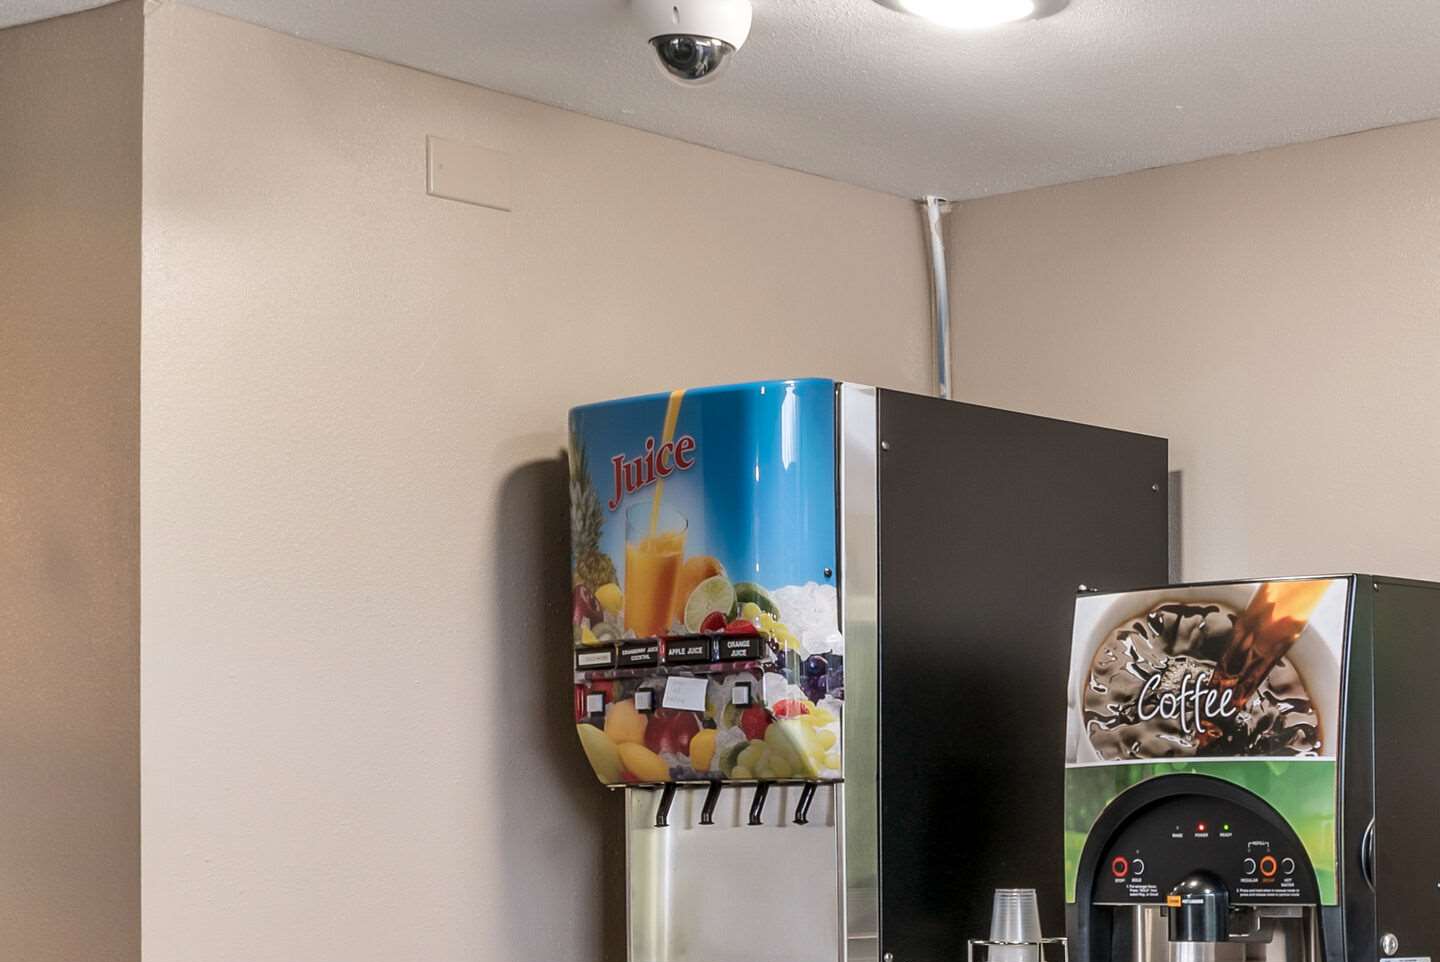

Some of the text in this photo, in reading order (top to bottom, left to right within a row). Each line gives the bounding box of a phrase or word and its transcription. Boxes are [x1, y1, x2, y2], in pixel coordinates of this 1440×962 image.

[608, 436, 696, 511] Juice
[727, 640, 750, 649] ORANGE
[668, 646, 703, 656] APPLE JUICE
[730, 649, 747, 657] JUICE
[1138, 673, 1236, 733] Coffee
